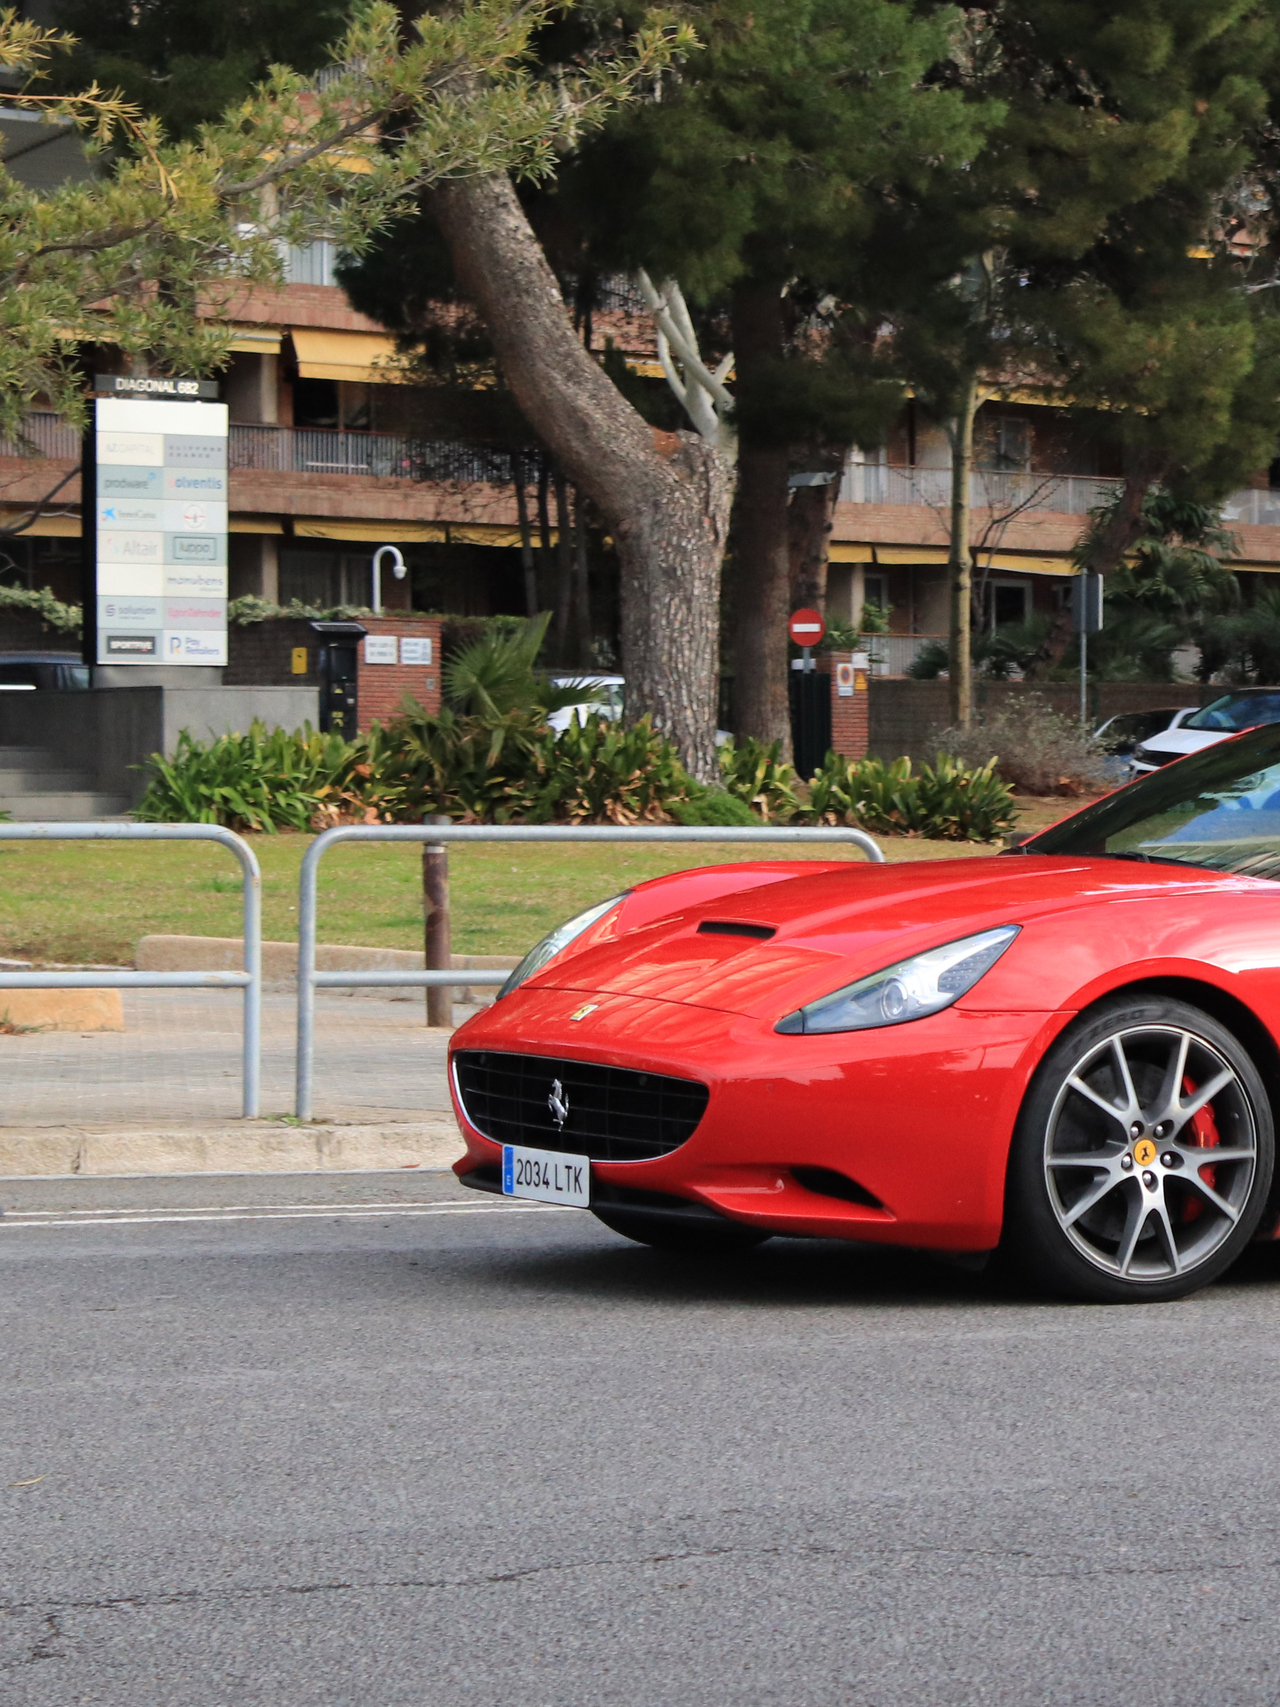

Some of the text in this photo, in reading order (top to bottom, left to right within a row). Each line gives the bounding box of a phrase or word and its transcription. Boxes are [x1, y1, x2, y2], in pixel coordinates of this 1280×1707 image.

[115, 378, 199, 394] DIAGONAL 682
[516, 1158, 583, 1194] 2034 LTK
